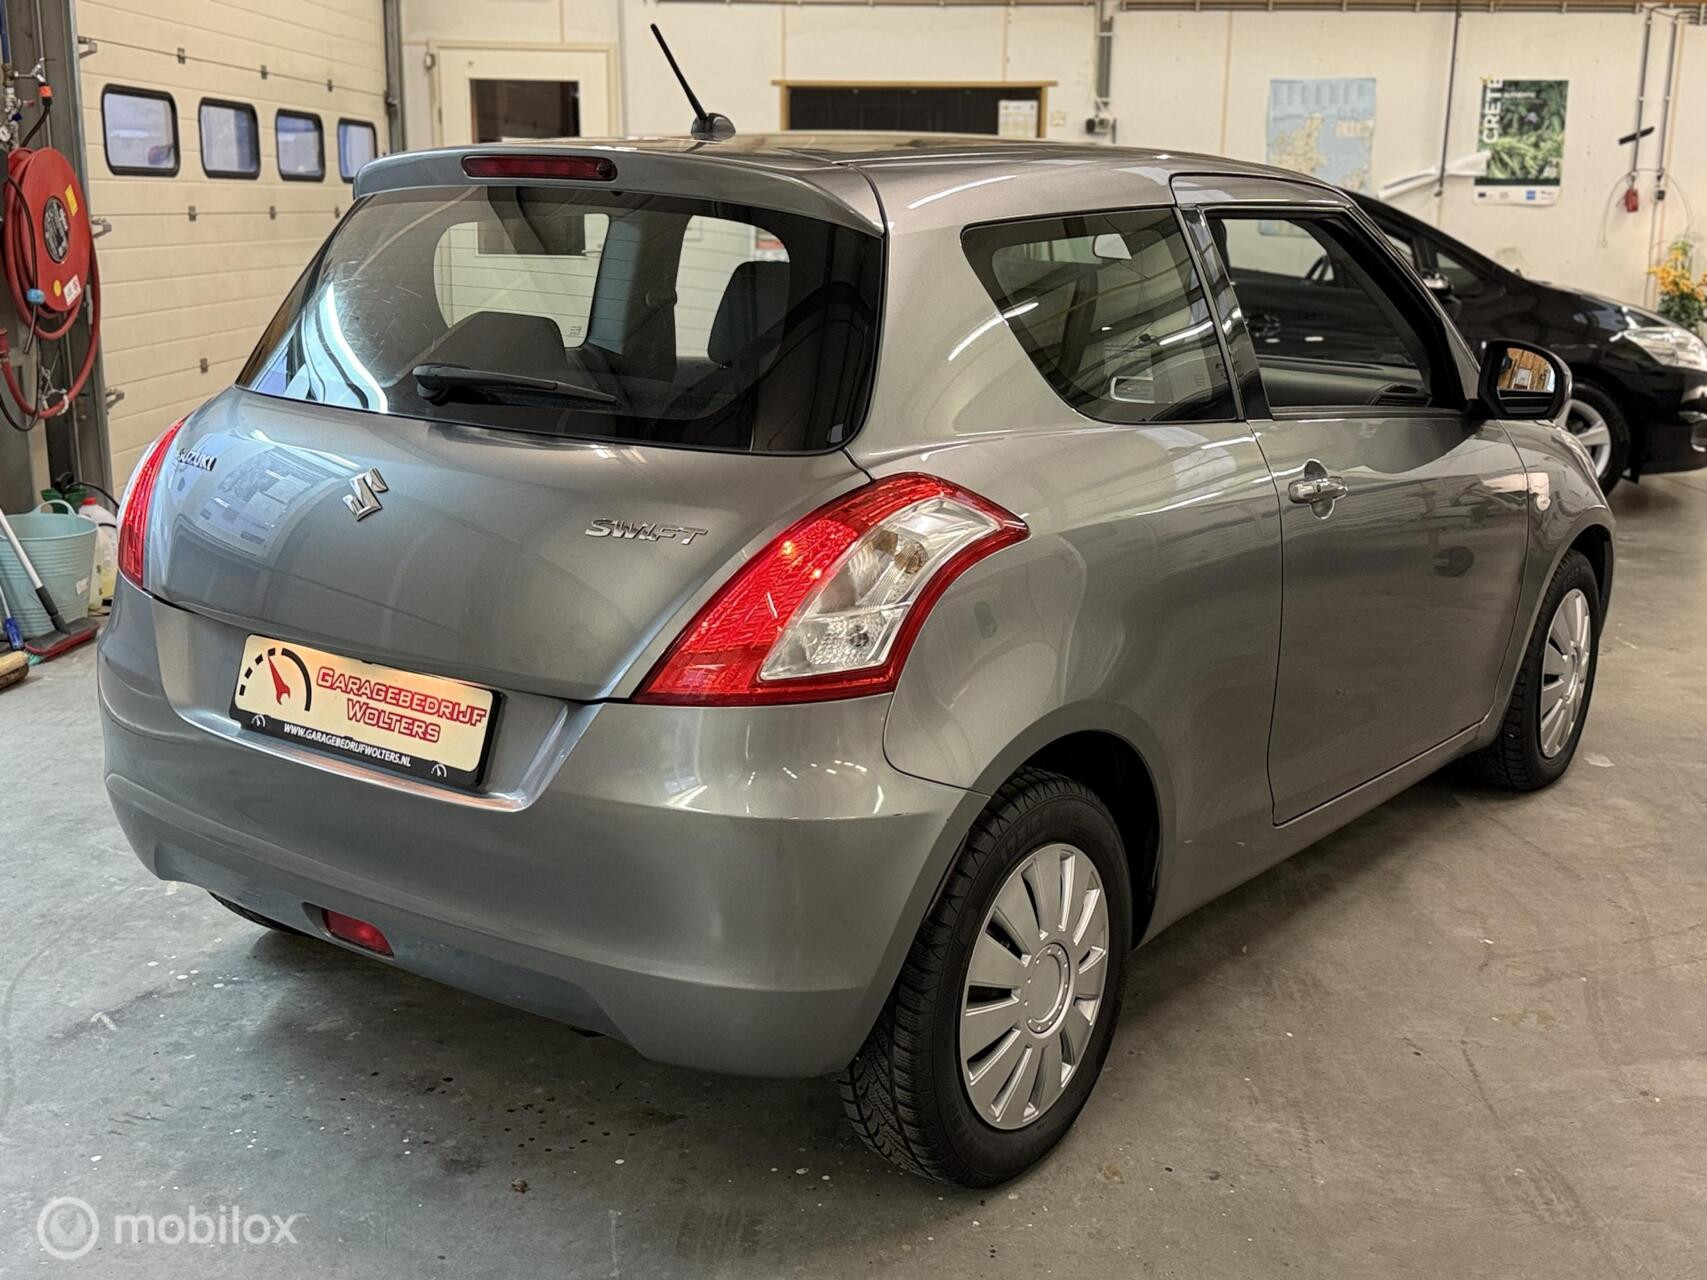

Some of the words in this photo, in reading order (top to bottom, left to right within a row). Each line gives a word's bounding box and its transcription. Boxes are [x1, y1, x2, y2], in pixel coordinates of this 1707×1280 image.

[1482, 78, 1504, 144] CRETE
[177, 448, 217, 471] SUZUKI
[584, 518, 709, 545] SWIFT
[316, 666, 488, 727] GARAGEBEDRIJF
[346, 697, 442, 743] WOLTERS
[283, 723, 412, 767] WWW.GARAGEBEDRIJFWOLTERS.NL
